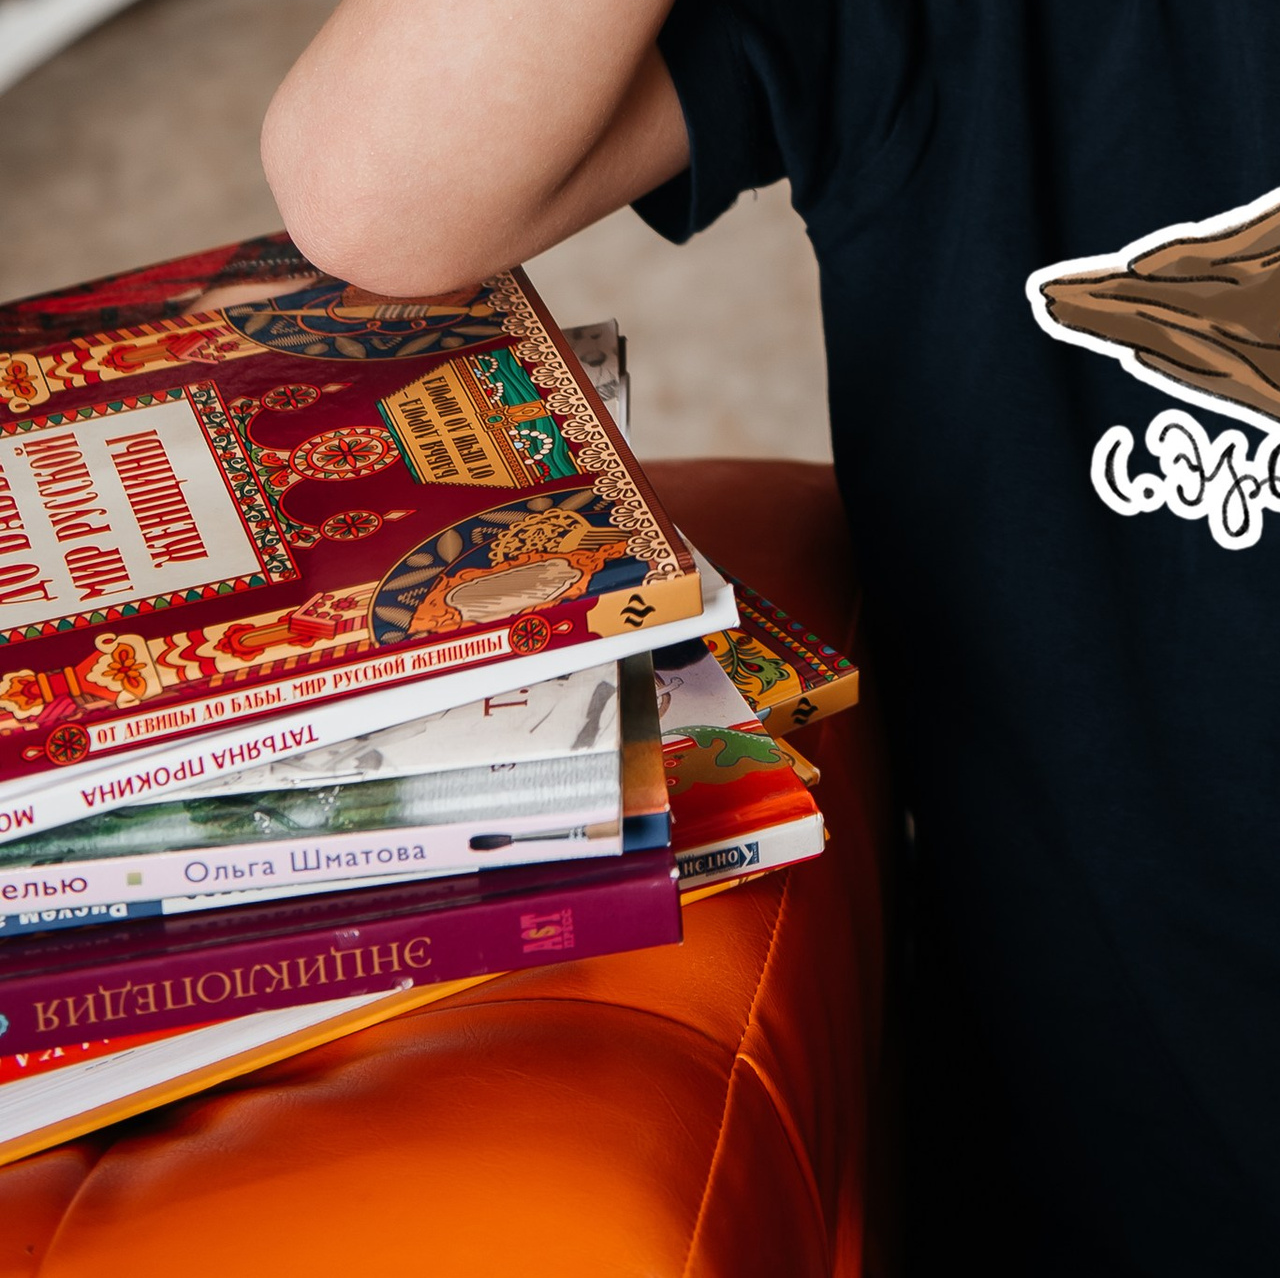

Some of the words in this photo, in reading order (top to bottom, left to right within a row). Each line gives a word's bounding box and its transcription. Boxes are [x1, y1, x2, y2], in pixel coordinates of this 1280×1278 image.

[421, 375, 467, 418] ПОРОГА
[398, 397, 442, 440] ДОРОГА
[443, 416, 475, 434] ДО
[419, 440, 459, 481] БАБЬЯ
[452, 433, 488, 465] ПЕЧИ
[14, 432, 112, 543] РУССКОЙ
[467, 463, 496, 480] ОТ
[105, 429, 209, 569] ЖЕНЩИНЫ
[63, 546, 134, 602] МИР
[97, 727, 118, 745] ОТ
[124, 709, 197, 742] ДЕВИЦЫ
[202, 702, 225, 725] ДО
[231, 689, 287, 714] БАБЫ.
[292, 677, 328, 700] МИР
[332, 655, 406, 691] РУССКОЙ
[411, 634, 503, 669] ЖЕНЩИНЫ
[215, 724, 319, 770] ТАТЬЯНА
[81, 756, 205, 807] ПРОКИНА
[184, 861, 275, 883] Ольга
[290, 845, 427, 873] Шматова
[679, 844, 757, 876] КОНТЭН
[33, 936, 433, 1033] ЭНЦИКЛОПЕДИЯ
